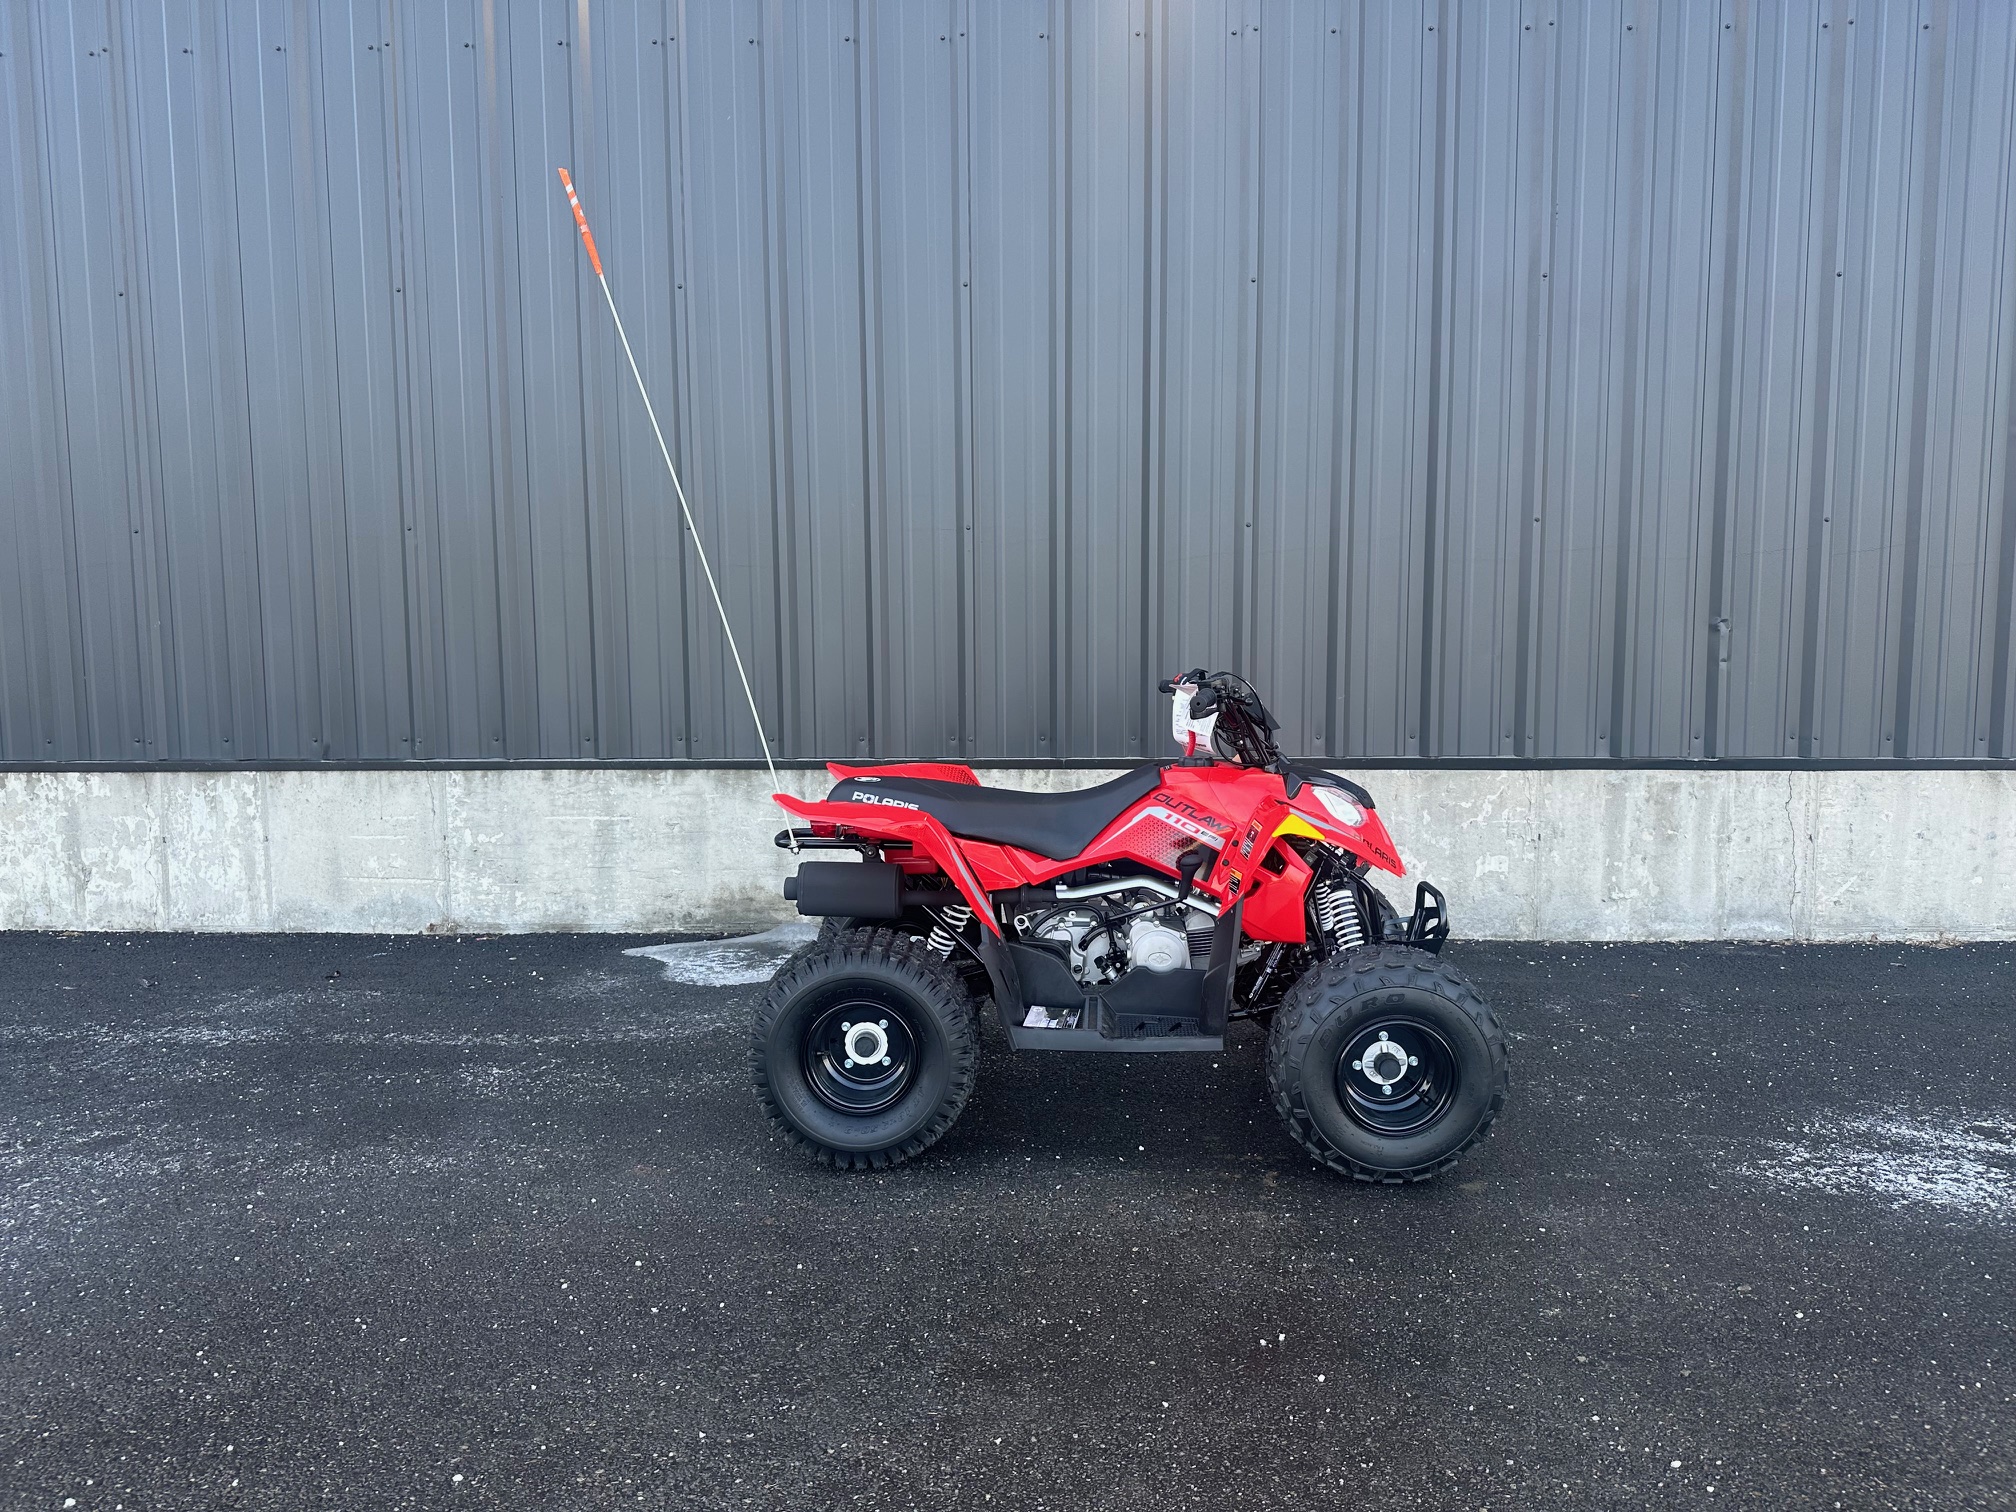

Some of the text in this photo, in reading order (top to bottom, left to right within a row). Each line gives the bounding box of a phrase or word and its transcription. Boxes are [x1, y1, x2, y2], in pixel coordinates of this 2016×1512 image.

[1153, 793, 1230, 831] OUTLAW
[1165, 813, 1201, 834] 110
[1318, 993, 1406, 1051] DURO
